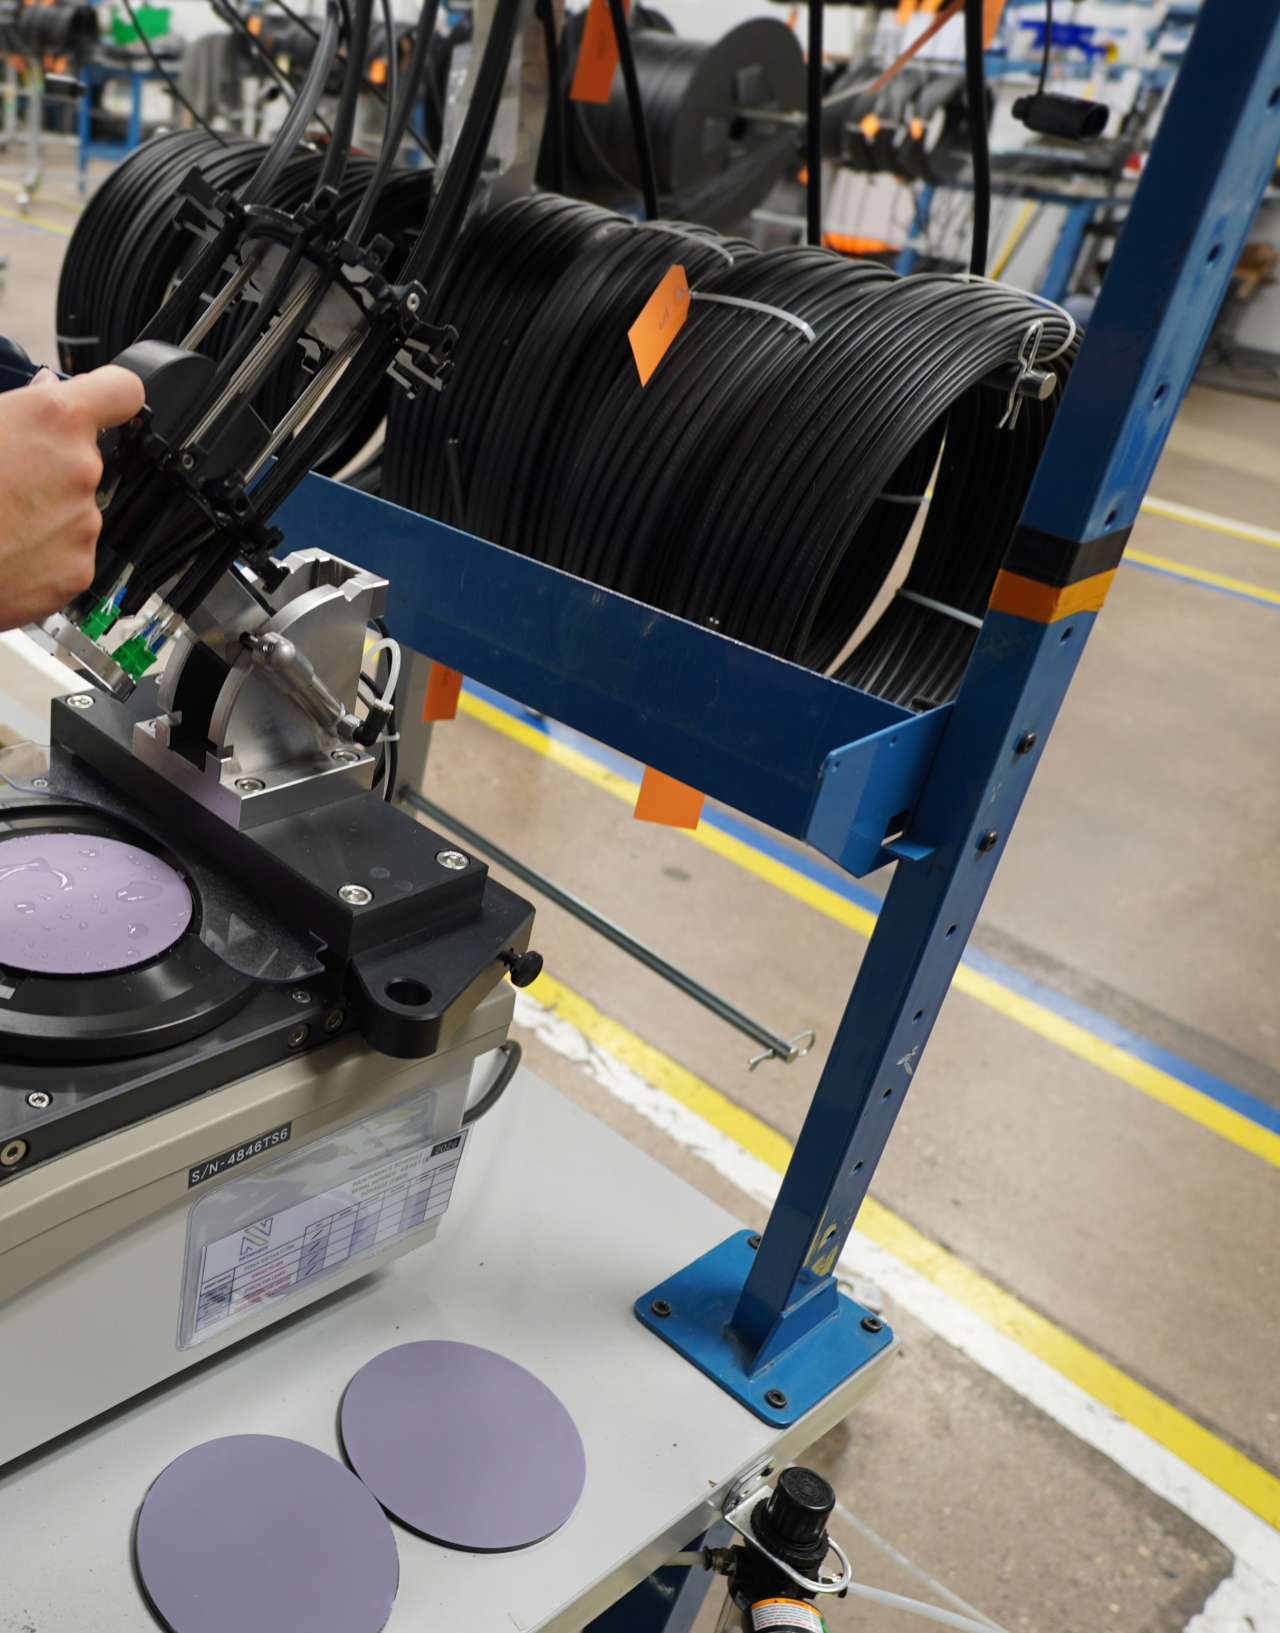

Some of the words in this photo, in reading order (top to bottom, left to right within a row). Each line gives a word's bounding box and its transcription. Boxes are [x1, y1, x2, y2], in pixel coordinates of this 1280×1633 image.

[191, 1127, 289, 1183] S/N-4846TS6
[434, 1140, 458, 1155] 2026
[351, 1165, 394, 1188] MAINTENANCE
[393, 1152, 423, 1171] SCHEDULE
[350, 1183, 371, 1195] SERIAL
[359, 1182, 388, 1198] DOMAILLE
